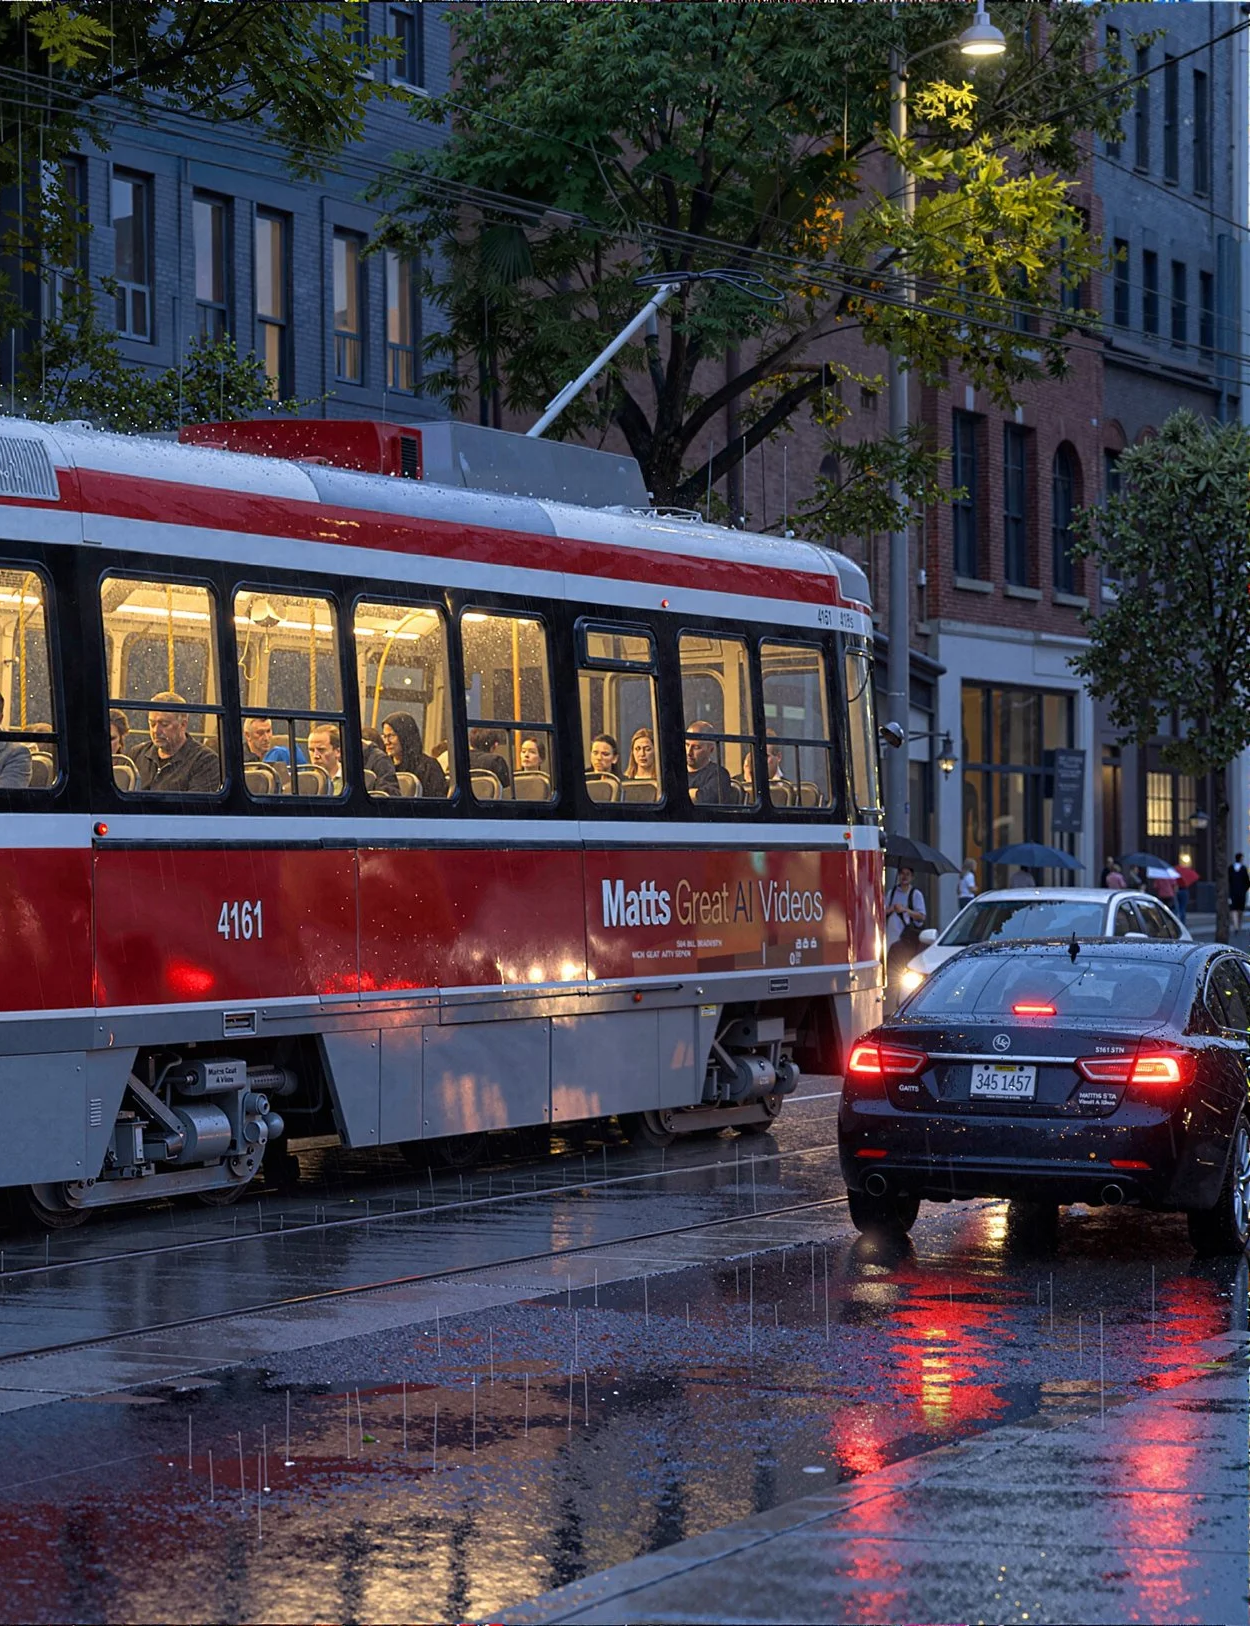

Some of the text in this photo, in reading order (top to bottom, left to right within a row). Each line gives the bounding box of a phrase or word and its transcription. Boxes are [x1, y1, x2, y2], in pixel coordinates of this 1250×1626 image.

[217, 900, 262, 940] 4161
[601, 879, 824, 928] Matts Great AI Videos
[976, 1073, 1031, 1092] 345 1457
